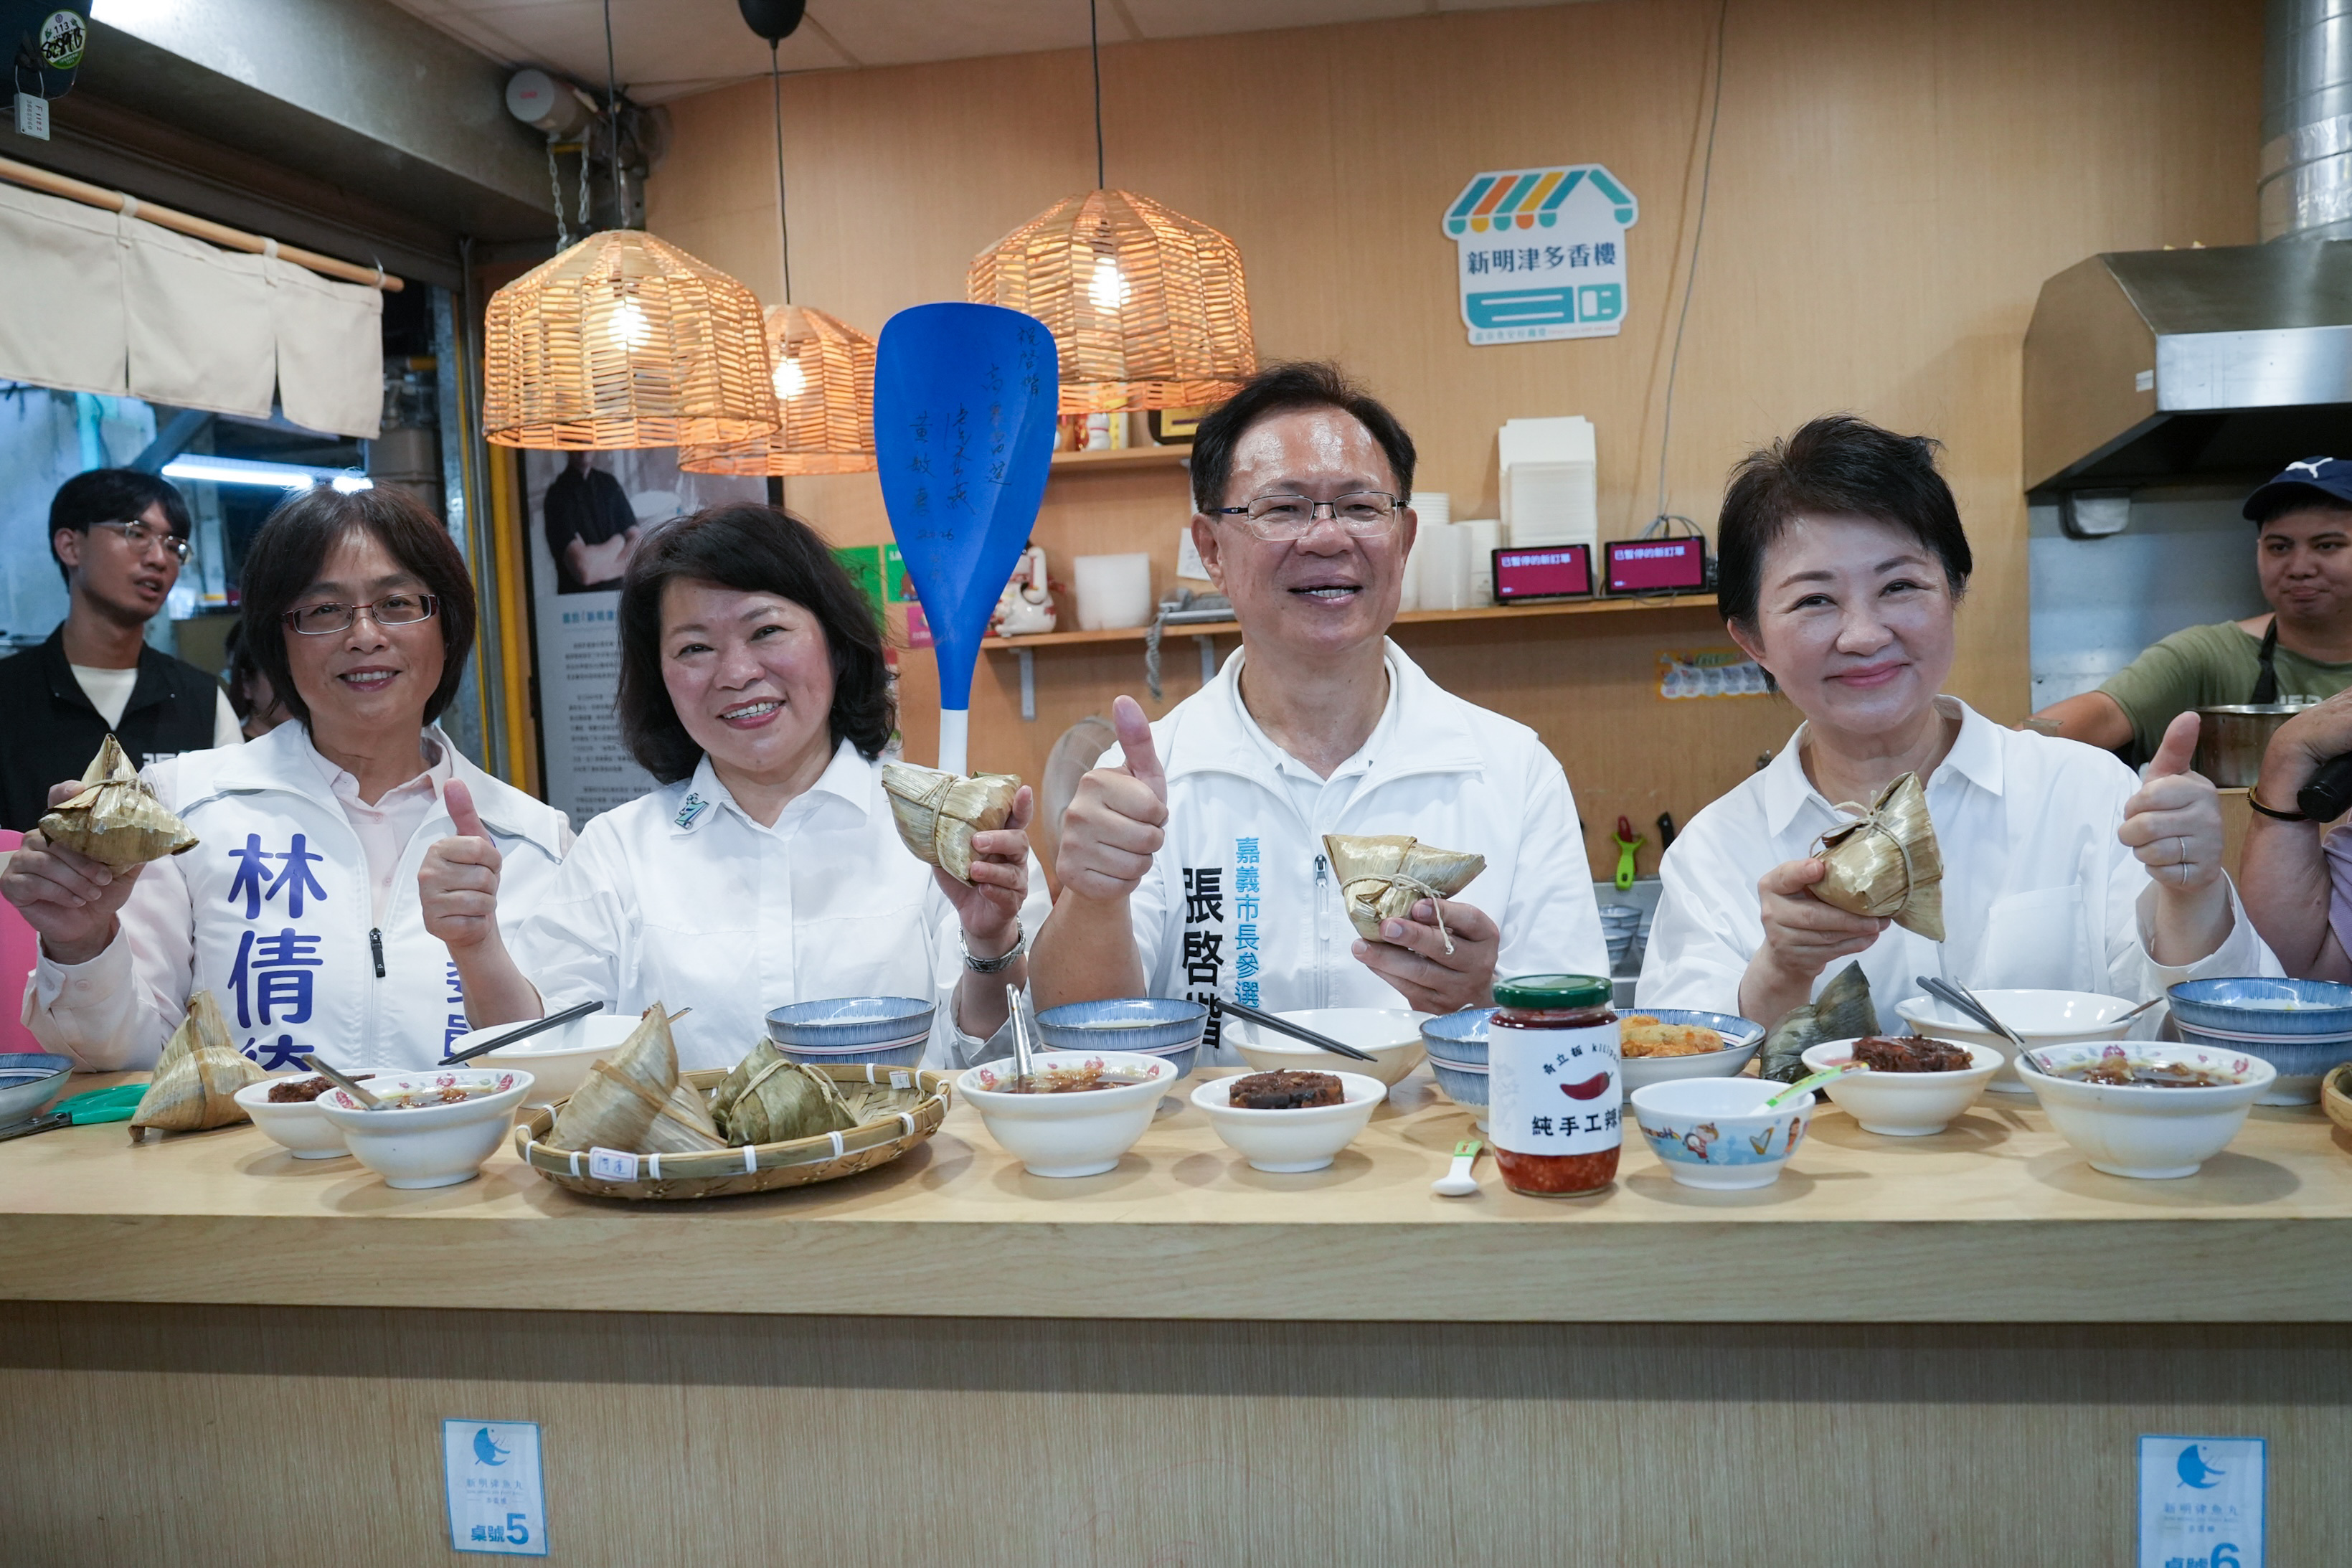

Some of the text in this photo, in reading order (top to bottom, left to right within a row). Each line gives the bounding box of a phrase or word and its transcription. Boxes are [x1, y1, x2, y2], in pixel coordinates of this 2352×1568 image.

[1467, 242, 1616, 275] 新明津多香樓
[1234, 837, 1260, 1008] 嘉義市長參選
